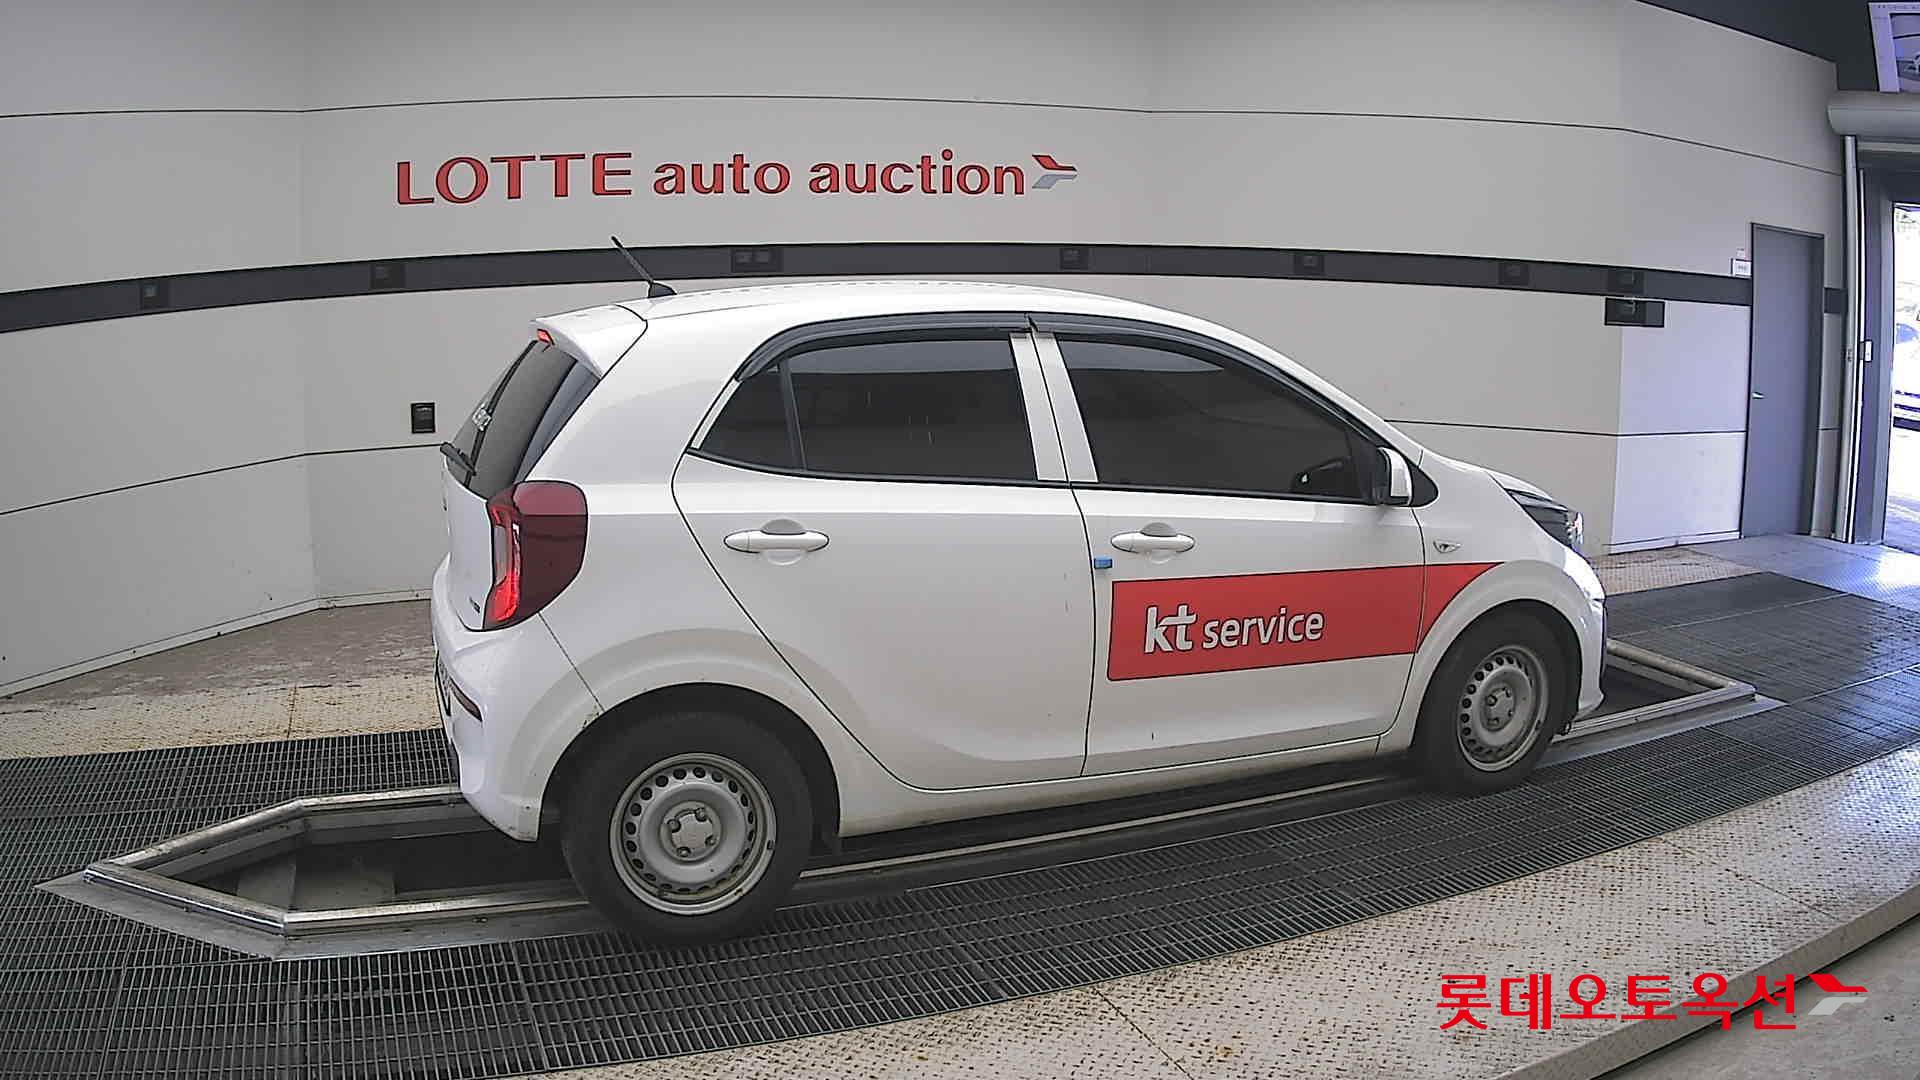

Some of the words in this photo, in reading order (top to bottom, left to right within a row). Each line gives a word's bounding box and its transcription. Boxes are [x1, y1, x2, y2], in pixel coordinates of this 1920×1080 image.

[397, 152, 632, 206] LOTTE
[653, 153, 792, 195] auto
[808, 149, 1025, 196] auction
[1143, 604, 1197, 654] kt
[1202, 607, 1325, 650] service
